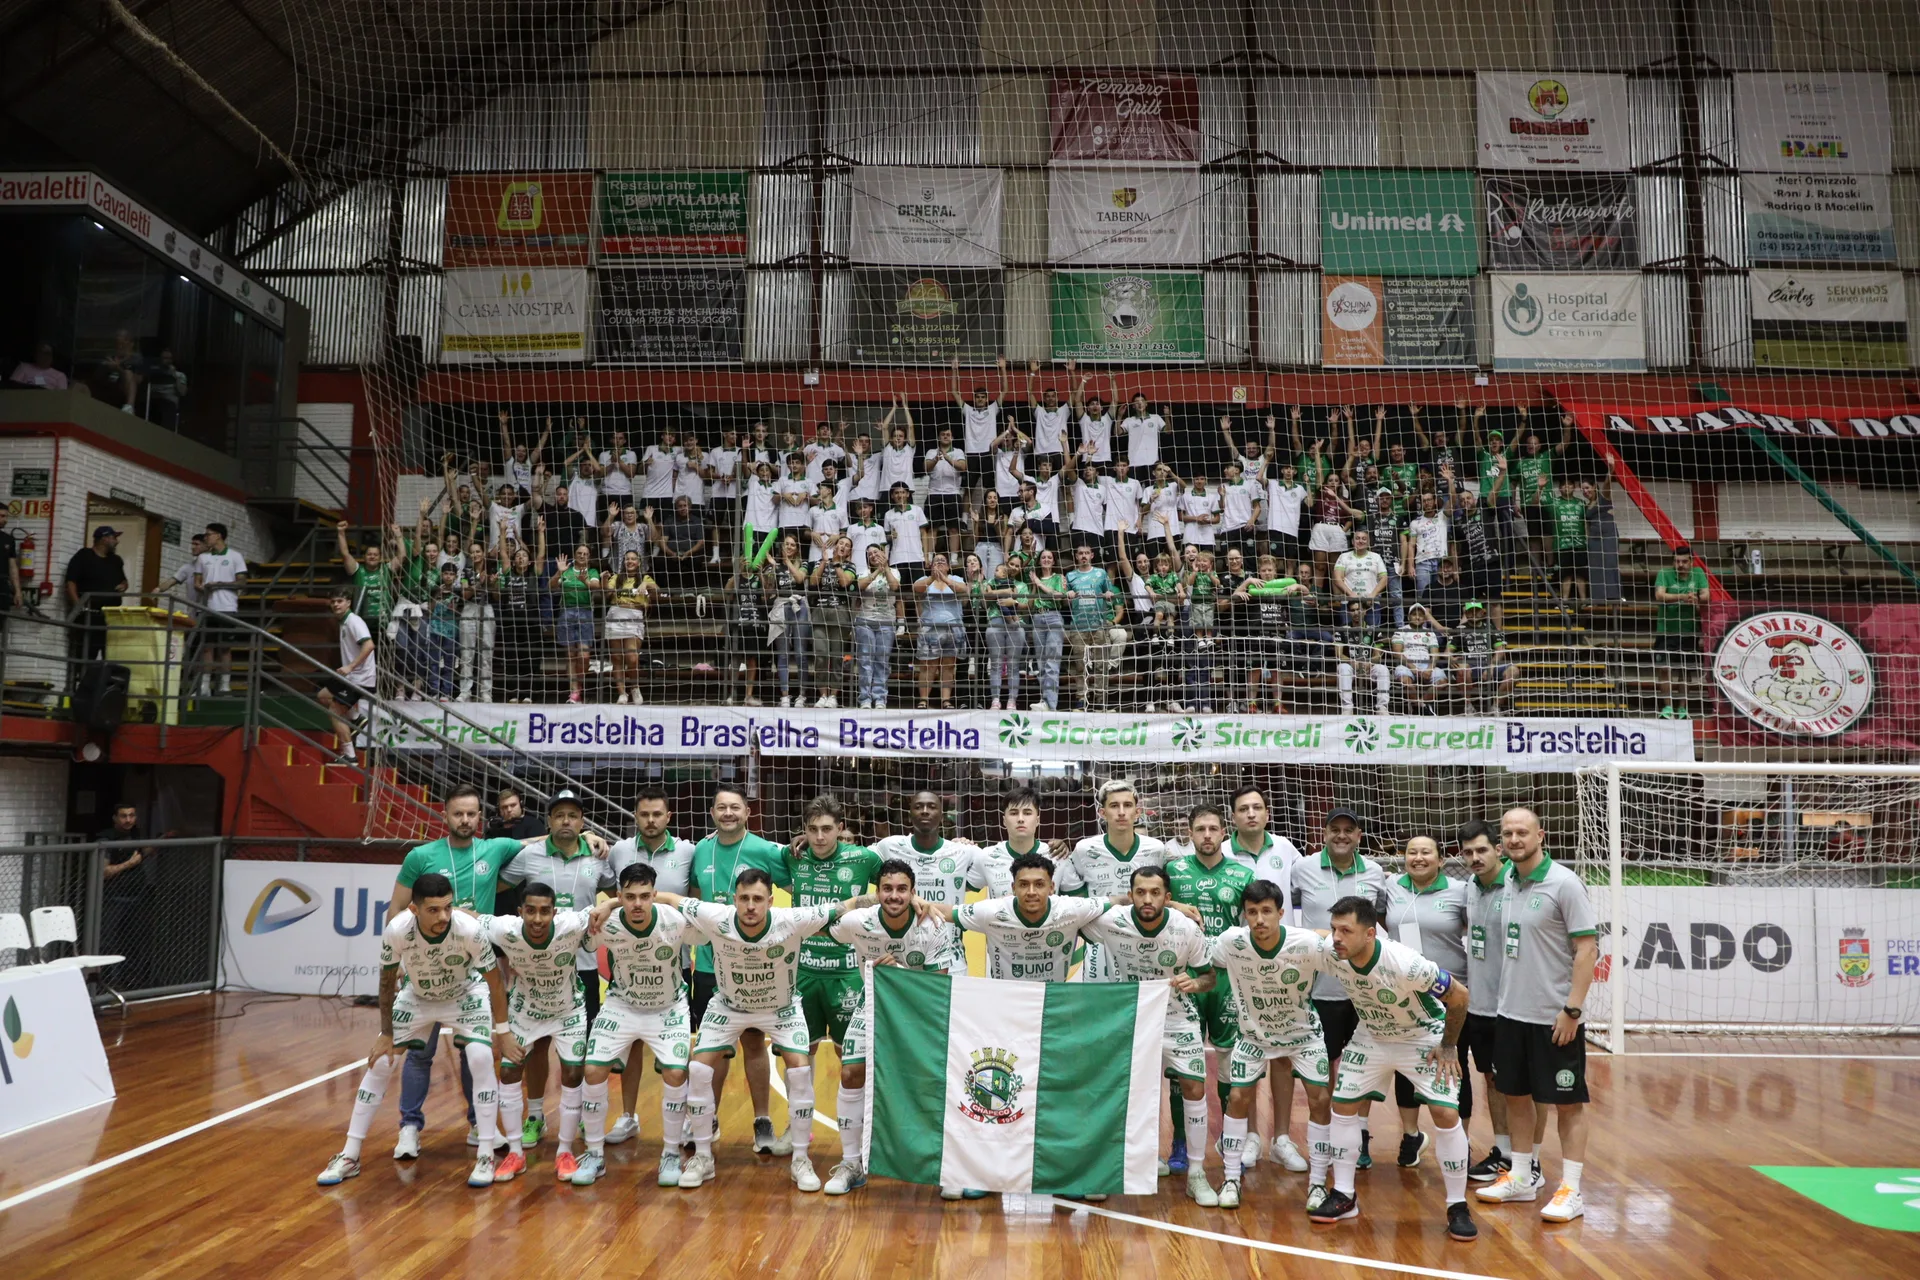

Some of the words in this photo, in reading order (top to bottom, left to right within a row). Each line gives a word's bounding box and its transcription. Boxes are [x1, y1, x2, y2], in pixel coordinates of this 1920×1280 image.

[0, 176, 86, 199] avaletti
[609, 180, 696, 190] Restaurante
[667, 192, 740, 206] PALADAR
[94, 182, 151, 238] Cavaletti
[898, 204, 956, 217] GENERAL
[1096, 211, 1151, 222] TABERNA
[1528, 196, 1636, 224] Restaurante
[1330, 211, 1432, 232] Unimed
[637, 280, 672, 292] ALTO
[678, 280, 739, 291] URUGUAI
[1826, 285, 1888, 296] SERVIMOS
[1547, 292, 1607, 307] Hospital
[1768, 288, 1815, 307] Carlos
[458, 303, 503, 318] CASA
[508, 302, 575, 317] NOSTRA
[1549, 309, 1566, 321] de
[1572, 310, 1637, 322] Caridade
[1549, 329, 1602, 337] Erechim
[1735, 618, 1823, 648] CAMISA
[528, 713, 665, 746] Brastelha
[681, 716, 820, 748] Brastelha
[840, 718, 980, 750] Brastelha
[1040, 719, 1149, 746] Sicredi
[1213, 722, 1323, 749] Sicredi
[1386, 724, 1496, 750] Sicredi
[1506, 722, 1647, 755] Brastelha
[1025, 962, 1054, 974] UNO
[1432, 983, 1446, 994] C
